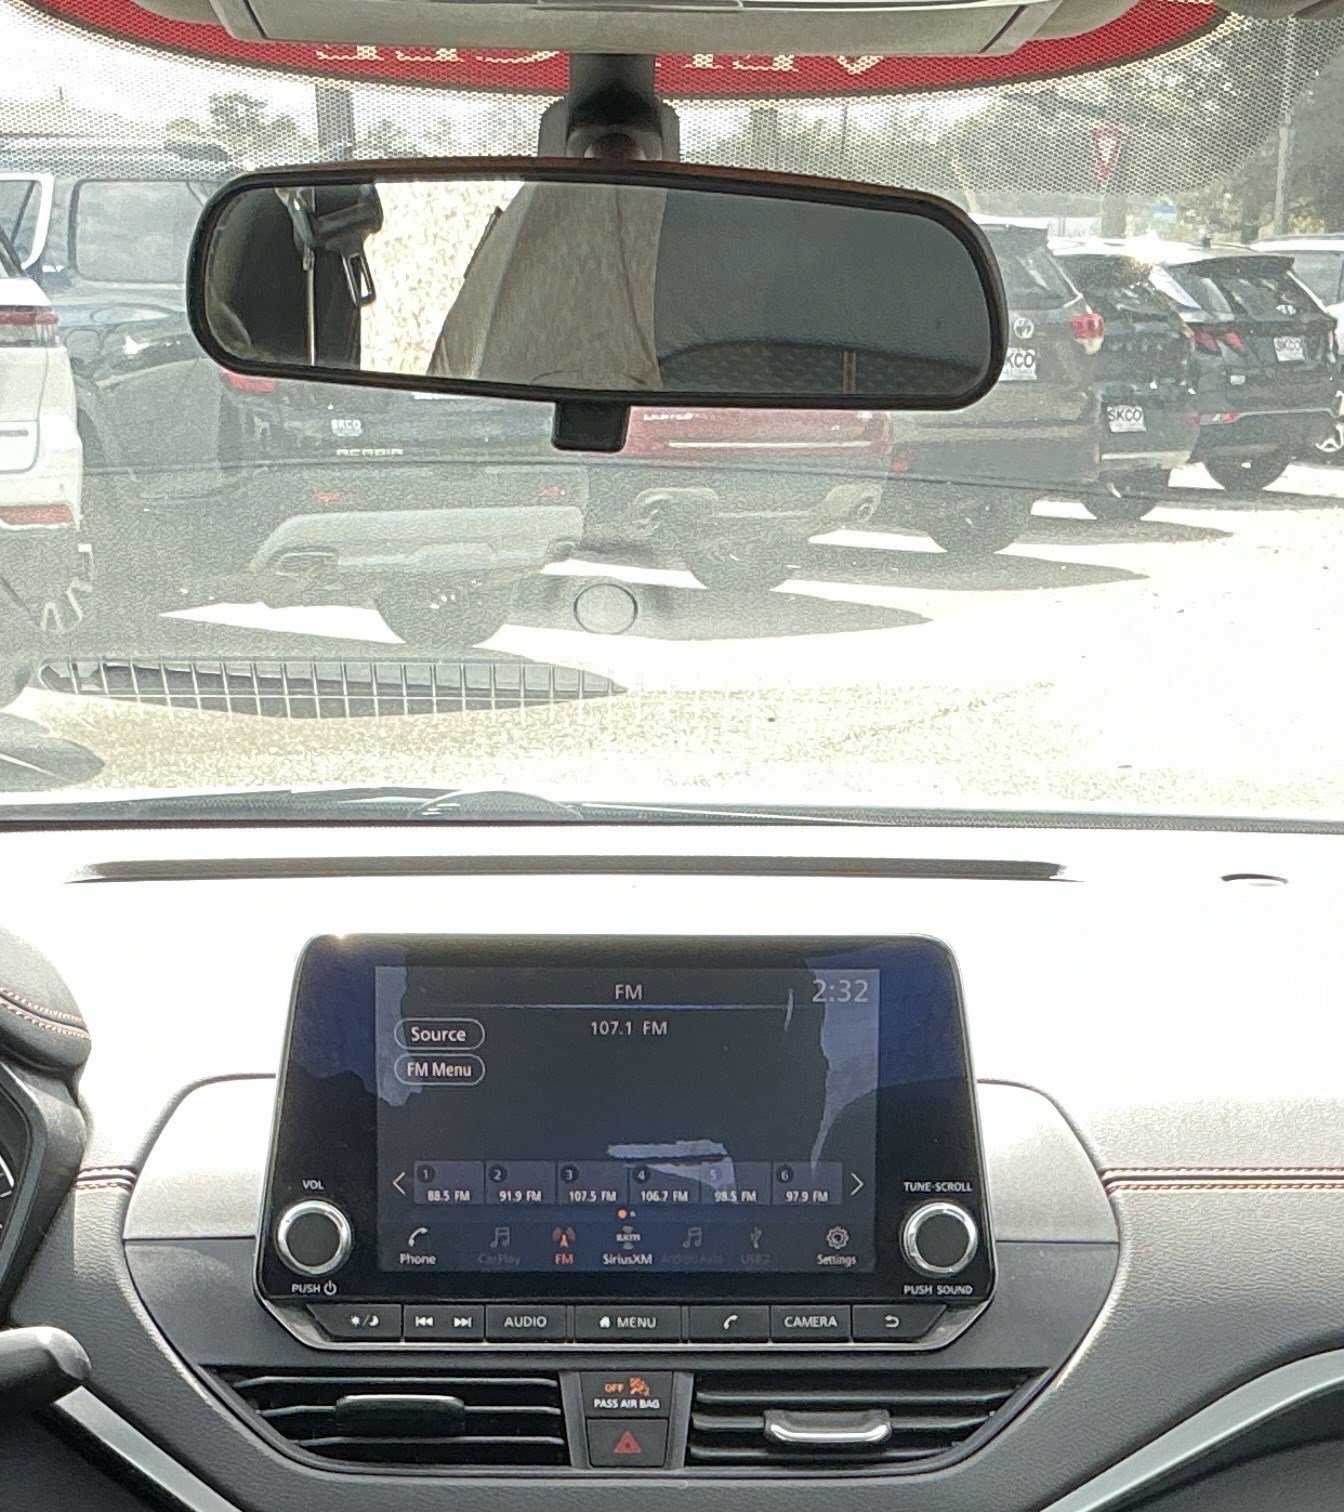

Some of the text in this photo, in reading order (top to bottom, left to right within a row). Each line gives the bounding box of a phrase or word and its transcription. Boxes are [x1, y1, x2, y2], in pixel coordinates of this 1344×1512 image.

[1005, 352, 1035, 368] KCO
[1108, 408, 1142, 422] SKCO
[615, 979, 869, 1003] FM 2:32
[410, 1026, 467, 1043] Source
[591, 1021, 668, 1036] 107.1 FM
[406, 1062, 472, 1077] FM Menu
[302, 1179, 325, 1191] VOL
[454, 1190, 471, 1202] FM
[499, 1190, 542, 1202] 91.9 FM
[569, 1190, 617, 1202] 107.5 FM
[672, 1190, 688, 1202] FM
[741, 1190, 757, 1202] FM
[786, 1190, 828, 1202] 97.9 FM
[399, 1254, 436, 1265] Phone
[555, 1254, 574, 1264] FM
[603, 1254, 653, 1265] SiriusXM
[817, 1254, 857, 1267] Settings
[292, 1283, 321, 1294] PUSH
[904, 1285, 973, 1296] PUSH SOUND
[504, 1316, 547, 1329] AUDIO
[617, 1316, 657, 1329] MENU
[784, 1315, 838, 1329] CAMERA
[594, 1398, 660, 1409] PASS AIR BAG
